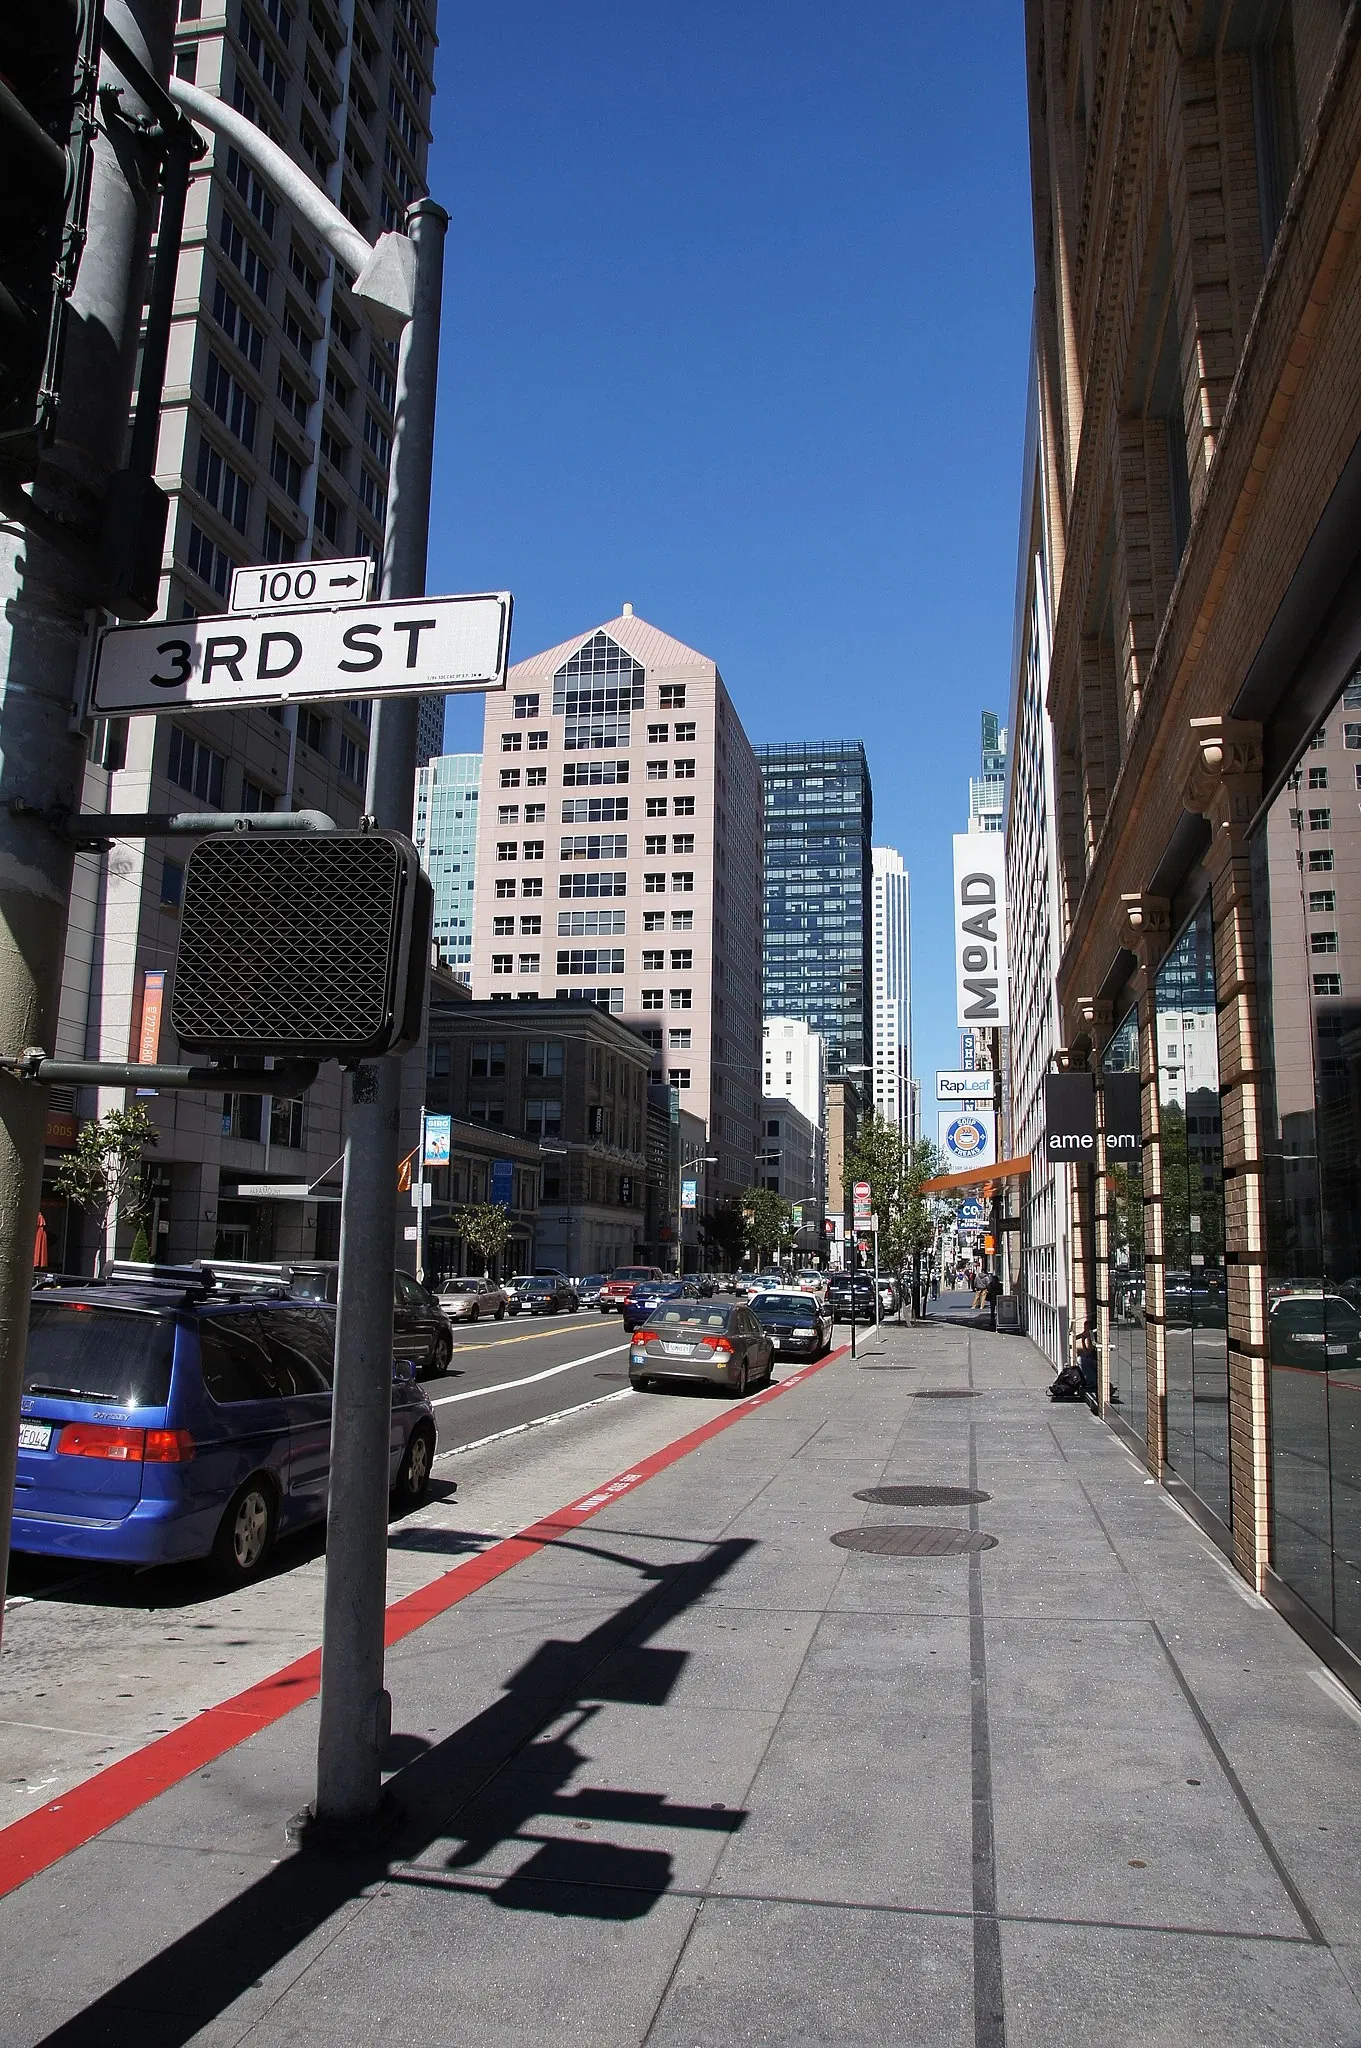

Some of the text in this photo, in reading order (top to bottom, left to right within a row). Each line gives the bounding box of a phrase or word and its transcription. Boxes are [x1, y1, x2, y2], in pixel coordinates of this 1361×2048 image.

[259, 569, 317, 602] 100
[150, 619, 437, 689] 3RD ST
[940, 1079, 991, 1093] RapLeaf
[957, 1118, 977, 1127] SOUP
[1049, 1134, 1094, 1149] ame
[953, 1146, 981, 1157] FREAKS
